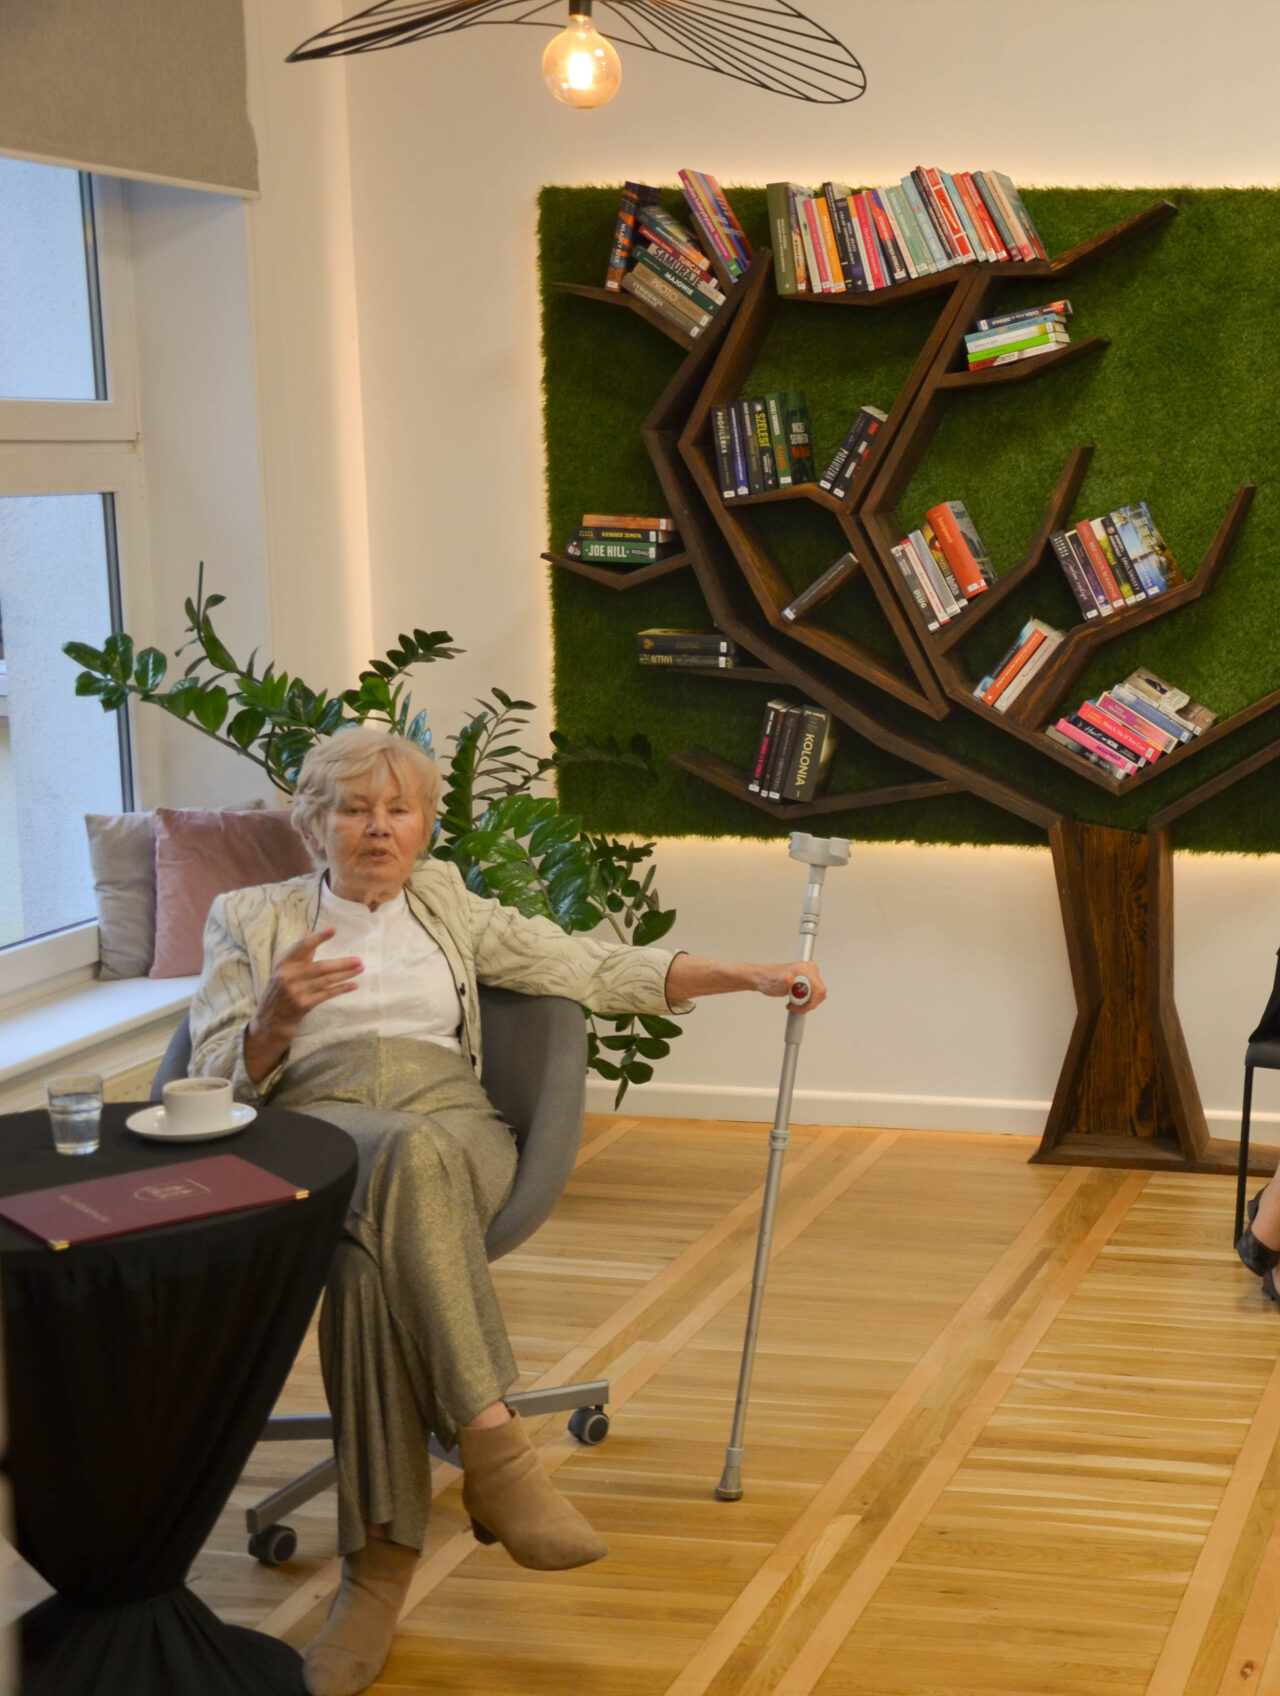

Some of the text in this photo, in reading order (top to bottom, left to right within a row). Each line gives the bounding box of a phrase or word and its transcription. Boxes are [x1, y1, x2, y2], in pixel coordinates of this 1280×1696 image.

[651, 246, 704, 287] SAMURAJE
[677, 254, 702, 275] TURCJA
[649, 277, 679, 302] PROTO
[662, 271, 694, 296] MAJOWIE
[754, 412, 769, 448] SZELEST
[587, 544, 605, 556] JOE
[606, 545, 627, 557] HILL
[794, 732, 815, 787] KOLONIA
